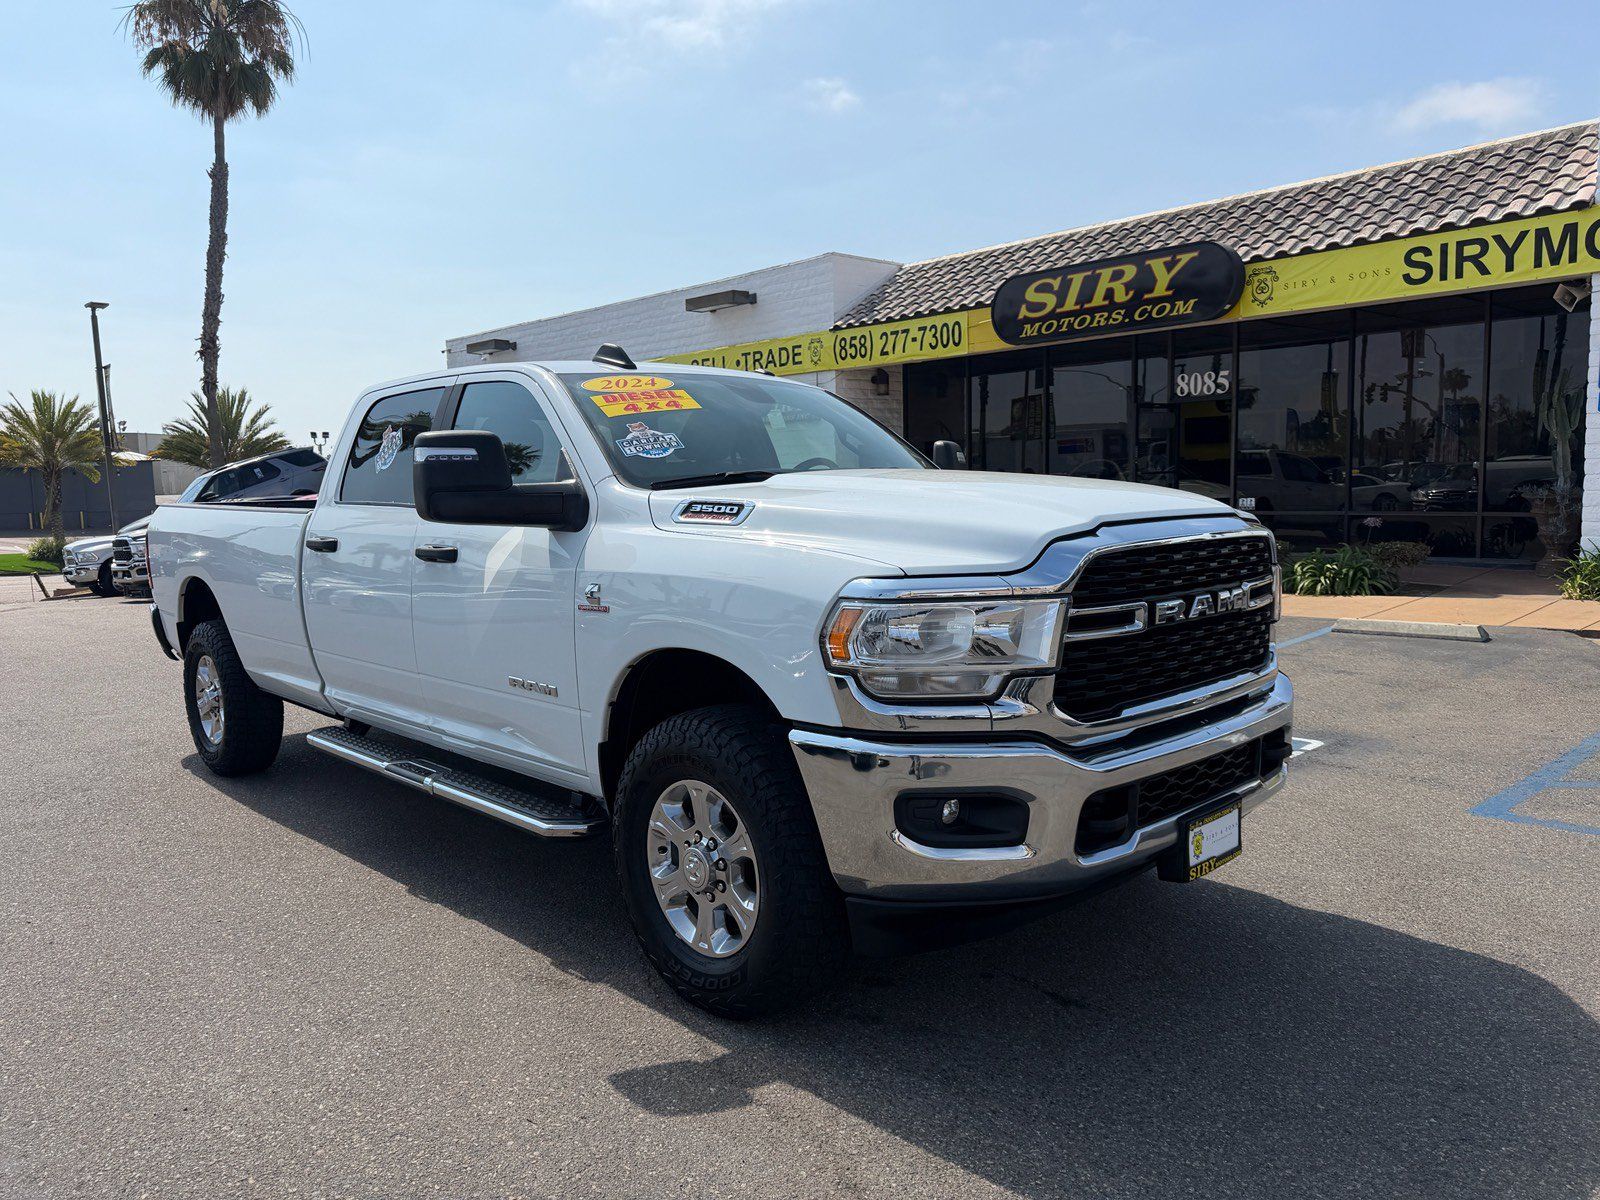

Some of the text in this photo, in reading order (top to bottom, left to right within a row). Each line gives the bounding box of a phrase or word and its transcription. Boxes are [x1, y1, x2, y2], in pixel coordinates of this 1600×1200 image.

[1017, 251, 1199, 320] SIRY
[1283, 267, 1392, 291] SIRY & SONS
[1019, 298, 1199, 338] MOTORS.COM
[833, 320, 963, 365] (858) 277-7300
[601, 377, 658, 390] 2024
[1176, 370, 1230, 397] 8085
[602, 389, 685, 404] DIESEL
[622, 434, 676, 447] CARFAX
[636, 441, 679, 452] OWNER
[690, 504, 739, 513] 3500
[1155, 586, 1249, 624] RAM
[509, 675, 558, 698] RAM
[1190, 857, 1217, 880] SIRY
